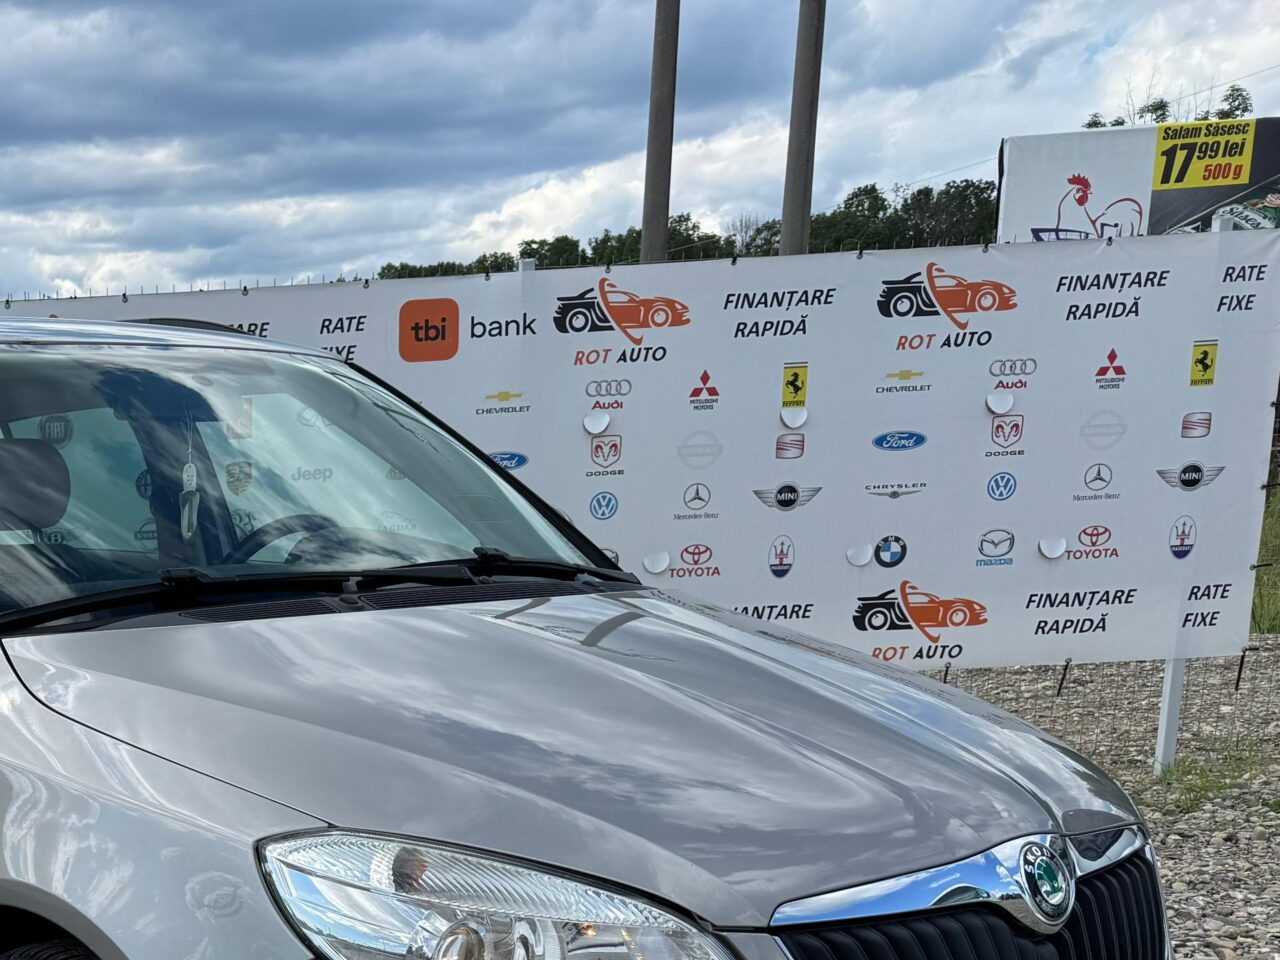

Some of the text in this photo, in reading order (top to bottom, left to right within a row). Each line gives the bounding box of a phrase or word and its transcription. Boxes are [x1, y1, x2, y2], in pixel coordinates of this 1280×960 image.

[1162, 121, 1250, 140] Salam Săsesc
[1160, 138, 1247, 185] 17 99 lei
[1202, 163, 1243, 181] 500 g
[1056, 270, 1170, 293] FINANȚARE
[1222, 264, 1267, 284] RATE
[724, 288, 836, 311] FINANȚARE
[1066, 296, 1141, 321] RAPIDĂ
[1216, 294, 1256, 312] FIXE
[320, 315, 367, 335] RATE
[411, 317, 447, 343] tbi
[471, 313, 537, 339] bank
[734, 314, 808, 338] RAPIDĂ
[896, 330, 992, 351] ROT AUTO
[574, 346, 667, 366] ROT AUTO
[876, 384, 932, 394] CHEVROLET
[476, 405, 531, 415] CHEVROLET
[882, 434, 917, 449] Ford
[985, 449, 1025, 457] DODGE
[291, 467, 333, 482] Jeep
[586, 469, 625, 477] DODGE
[1180, 471, 1202, 481] MINI
[865, 482, 927, 490] CHRYSLER
[775, 491, 798, 501] MINI
[1066, 548, 1119, 560] TOYOTA
[669, 566, 721, 579] TOYOTA
[1025, 589, 1137, 611] FINANȚARE
[1188, 583, 1232, 602] RATE
[1034, 612, 1109, 635] RAPIDĂ
[1182, 611, 1220, 629] FIXE
[871, 644, 962, 662] ROT AUTO
